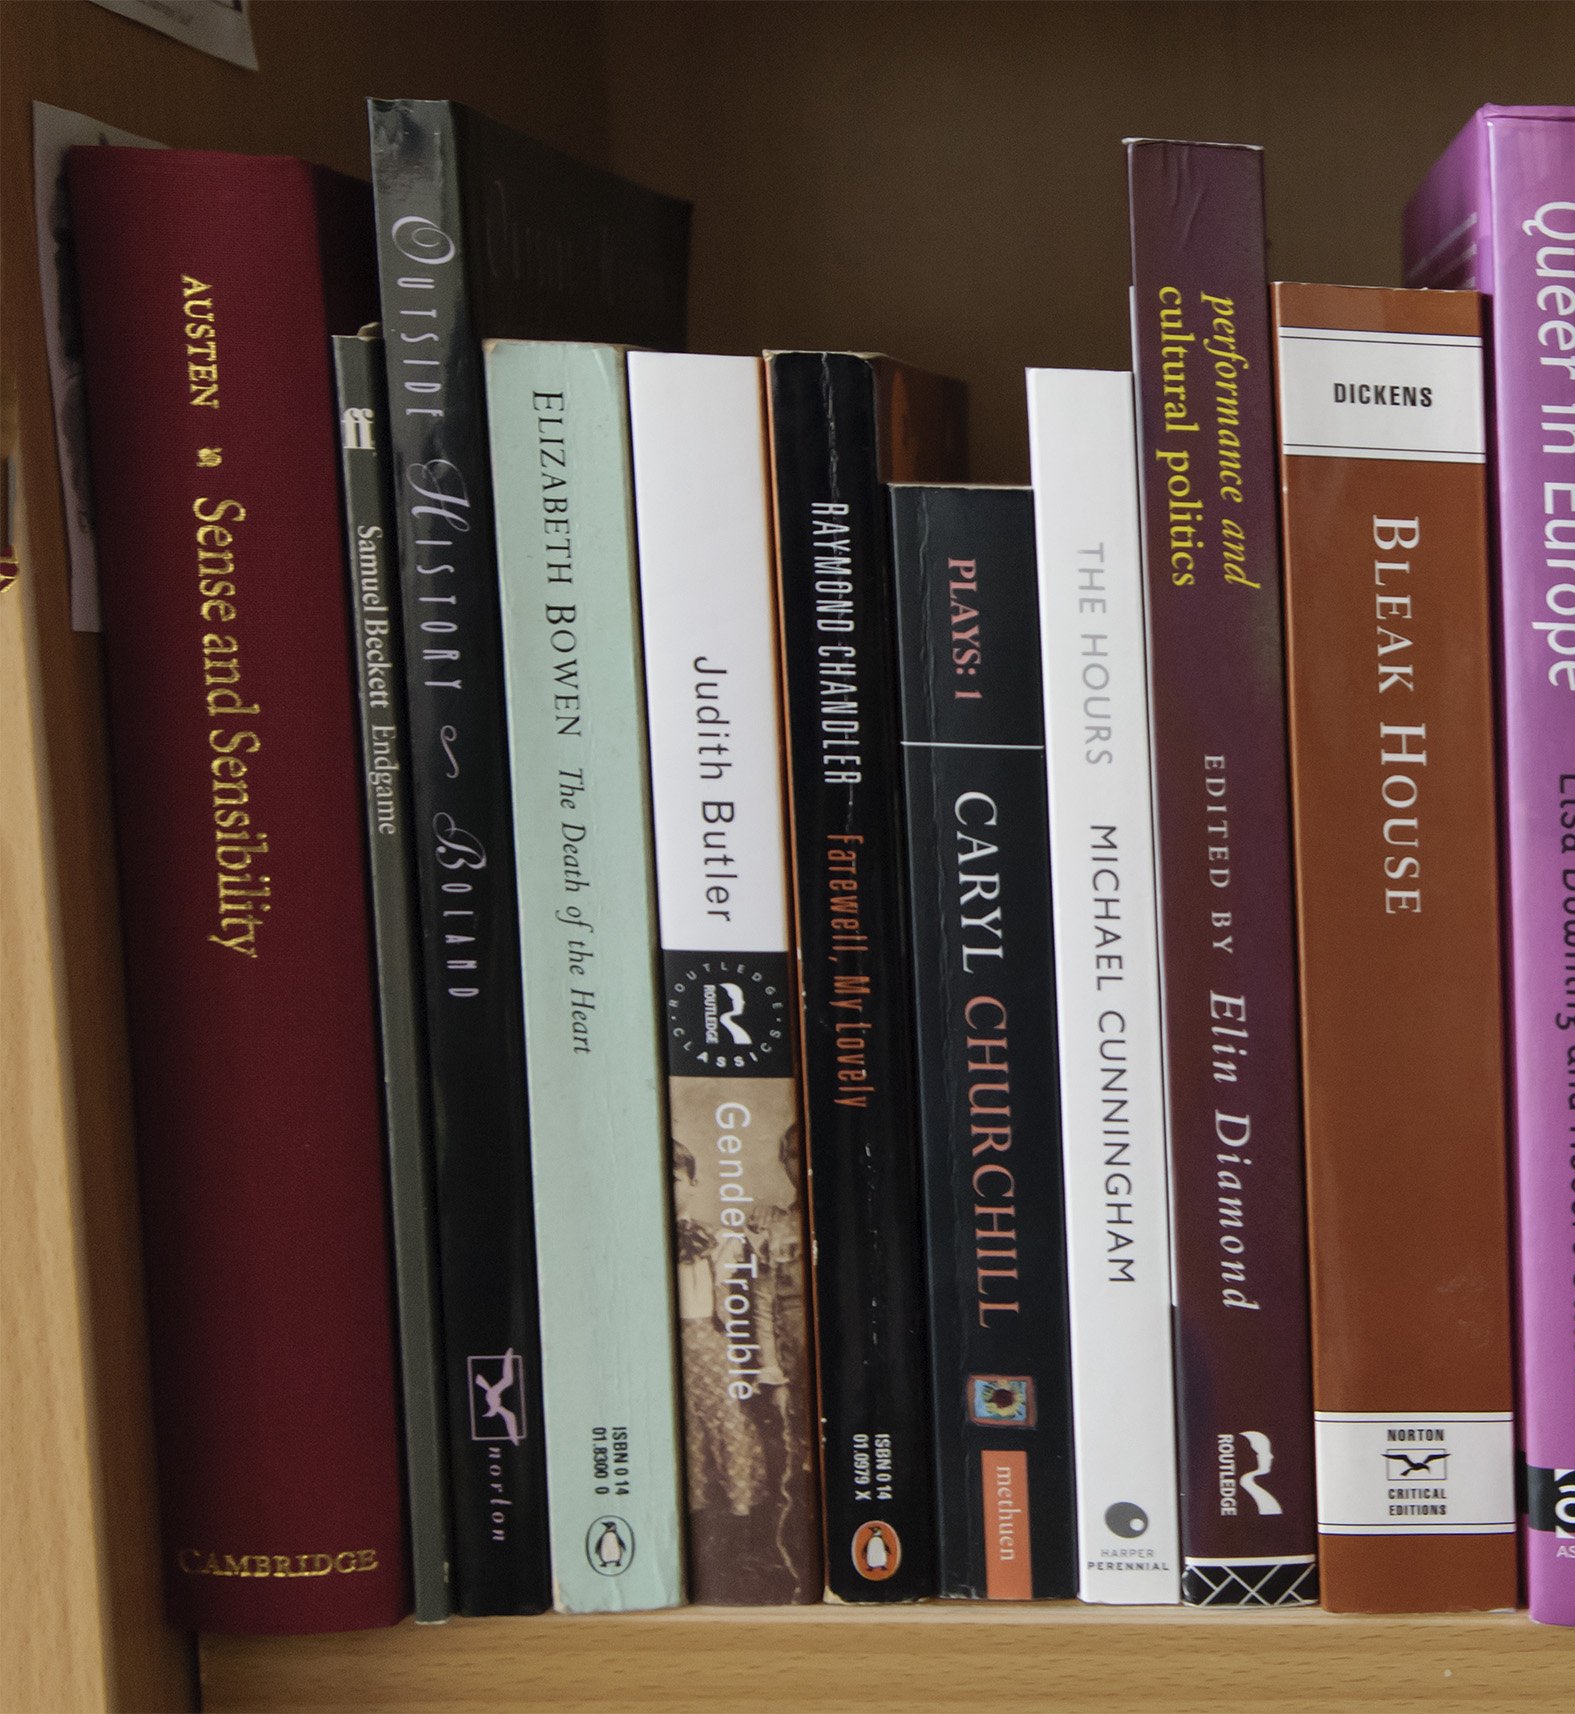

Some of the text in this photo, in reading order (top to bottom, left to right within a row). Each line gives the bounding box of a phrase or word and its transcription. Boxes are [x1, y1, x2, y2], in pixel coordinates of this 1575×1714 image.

[182, 275, 219, 409] AUSTEN
[1334, 383, 1432, 408] DICKENS
[1155, 286, 1205, 587] cultural politics
[1200, 291, 1262, 590] performance and
[358, 525, 391, 708] Samuel Beckett
[532, 391, 582, 736] ELIZABETH BOWEN
[811, 502, 862, 784] RAYMOND CHANDLER
[948, 558, 981, 675] PLAYS:
[1077, 541, 1114, 765] THE HOURS
[192, 497, 272, 959] Sense and Sensibility
[366, 724, 399, 835] Endgame
[693, 655, 739, 922] Judith Butler
[1373, 514, 1427, 914] BLEAK HOUSE
[826, 833, 875, 1109] Farewell, My Lovely
[954, 791, 1020, 1328] CARYL CHURCHILL
[1090, 825, 1136, 1283] MICHAEL CUNNINGHAM
[1210, 990, 1260, 1310] Elin Diamond
[715, 1101, 757, 1399] Gender Trouble
[487, 1446, 509, 1542] norton
[996, 1466, 1020, 1562] methuen
[1218, 1434, 1237, 1516] ROUTLEDGE
[1387, 1429, 1445, 1443] NORTON
[1388, 1488, 1447, 1501] CRITICAL
[1388, 1504, 1447, 1516] EDITIONS
[179, 1549, 379, 1579] CAMBRIDGE
[1087, 1561, 1170, 1573] PERENNIAL
[1100, 1548, 1155, 1559] HARPER
